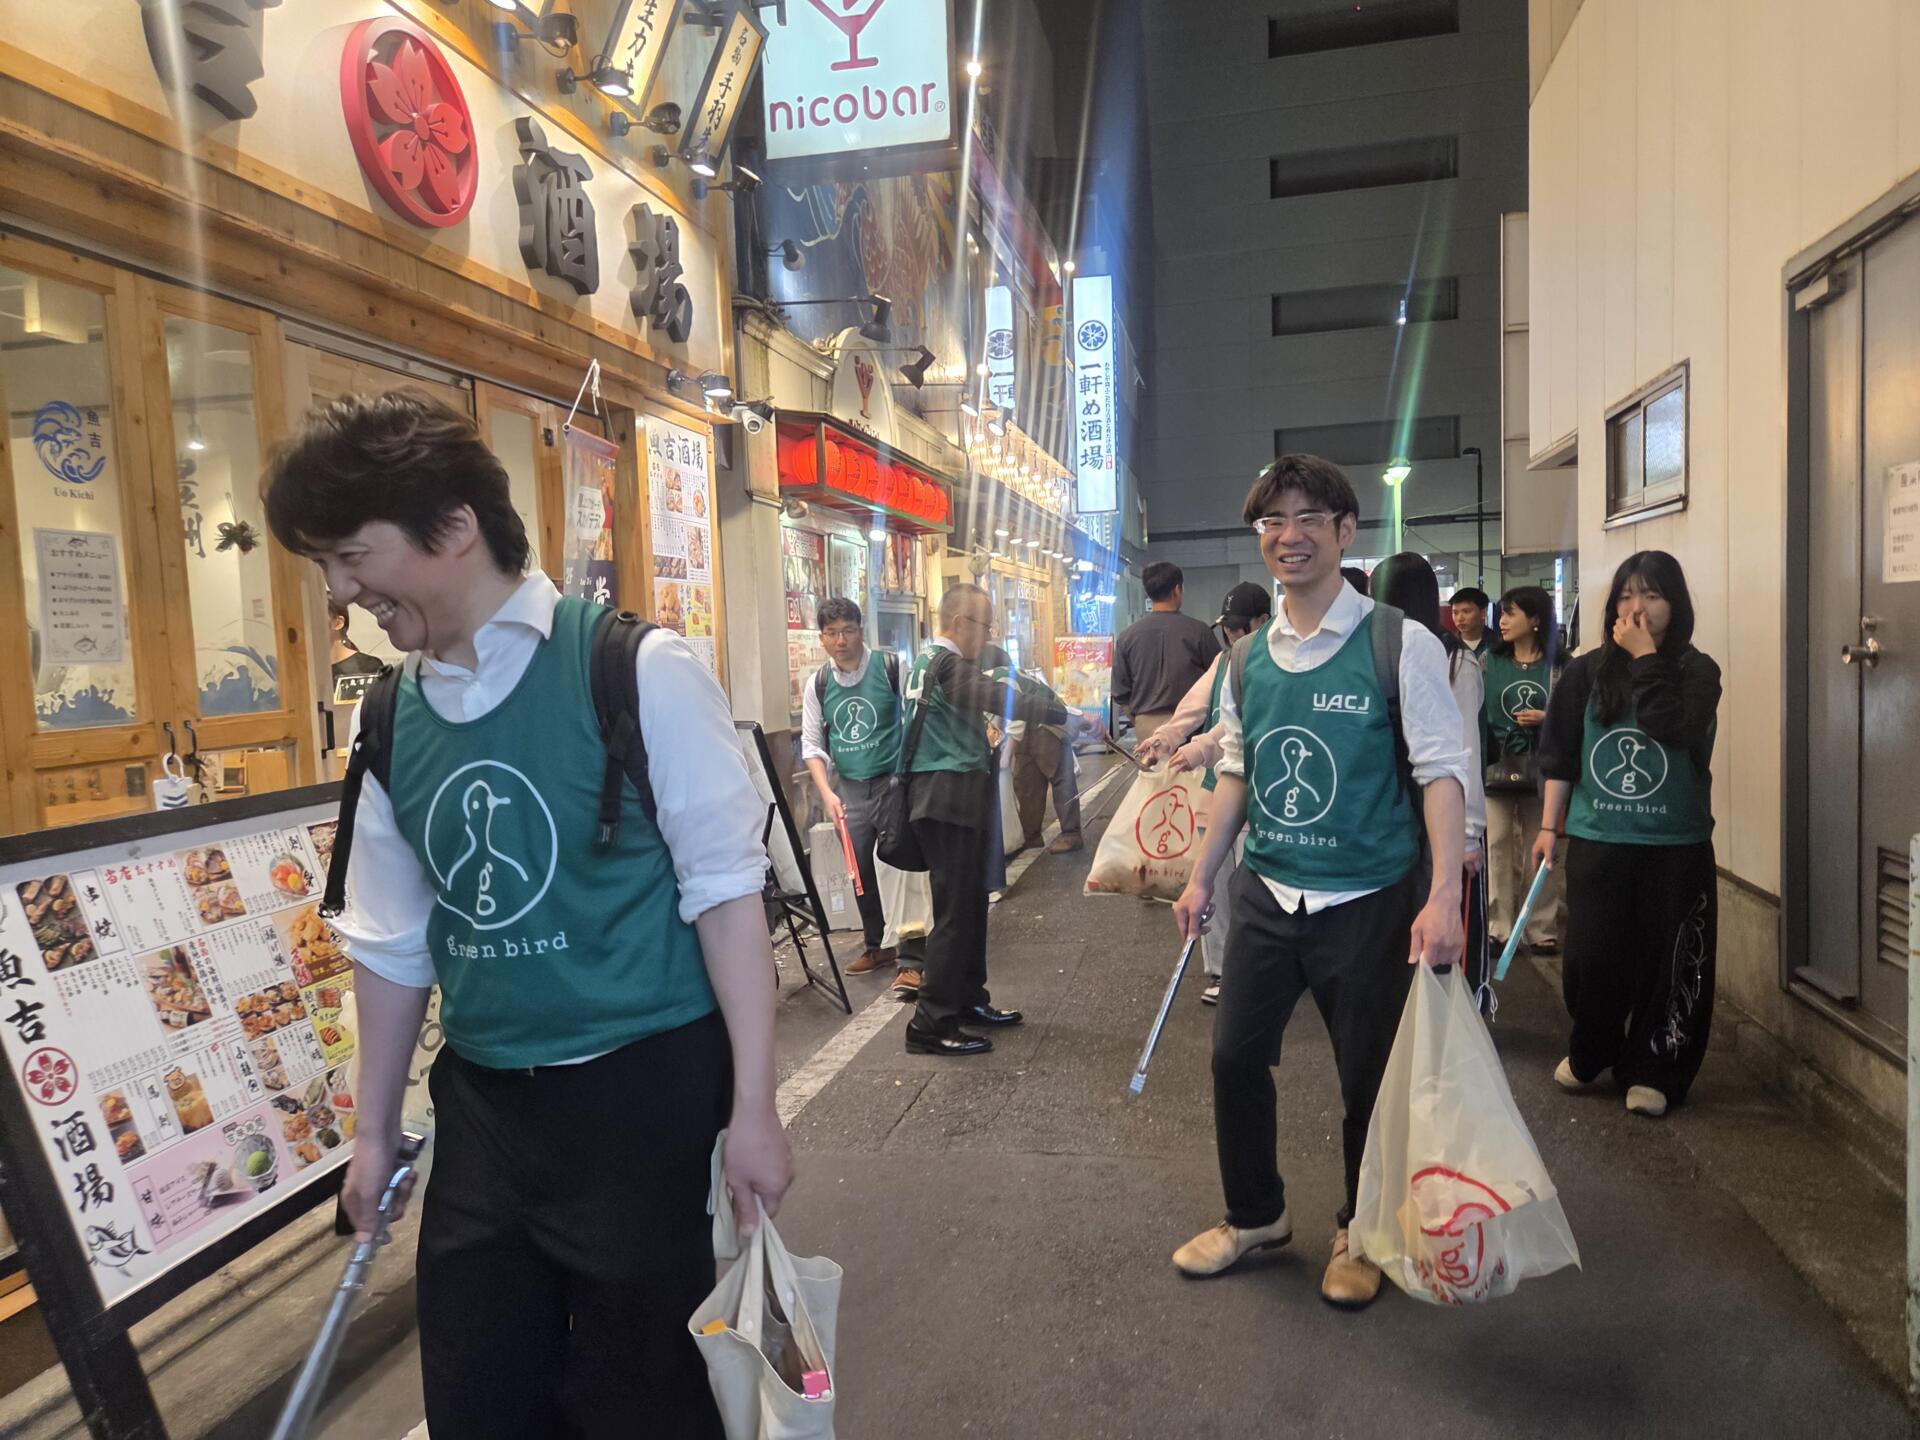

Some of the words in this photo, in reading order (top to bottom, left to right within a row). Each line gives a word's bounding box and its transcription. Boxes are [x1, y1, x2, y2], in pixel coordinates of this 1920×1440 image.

[770, 82, 936, 132] nicobar
[86, 409, 101, 449] 魚吉
[1079, 363, 1104, 470] 一軒め酒場
[54, 487, 69, 498] Uo
[69, 488, 95, 500] Kichi
[50, 549, 109, 560] おすすめメニュー
[1066, 650, 1105, 662] サービス
[1312, 692, 1371, 711] UACJ
[1636, 802, 1668, 815] bird
[1299, 832, 1338, 848] bird
[104, 860, 177, 887] 当店おすすめ
[85, 884, 117, 940] 串焼
[502, 931, 570, 958] bird
[234, 1046, 260, 1093] 小籠包
[50, 1111, 116, 1214] 酒場
